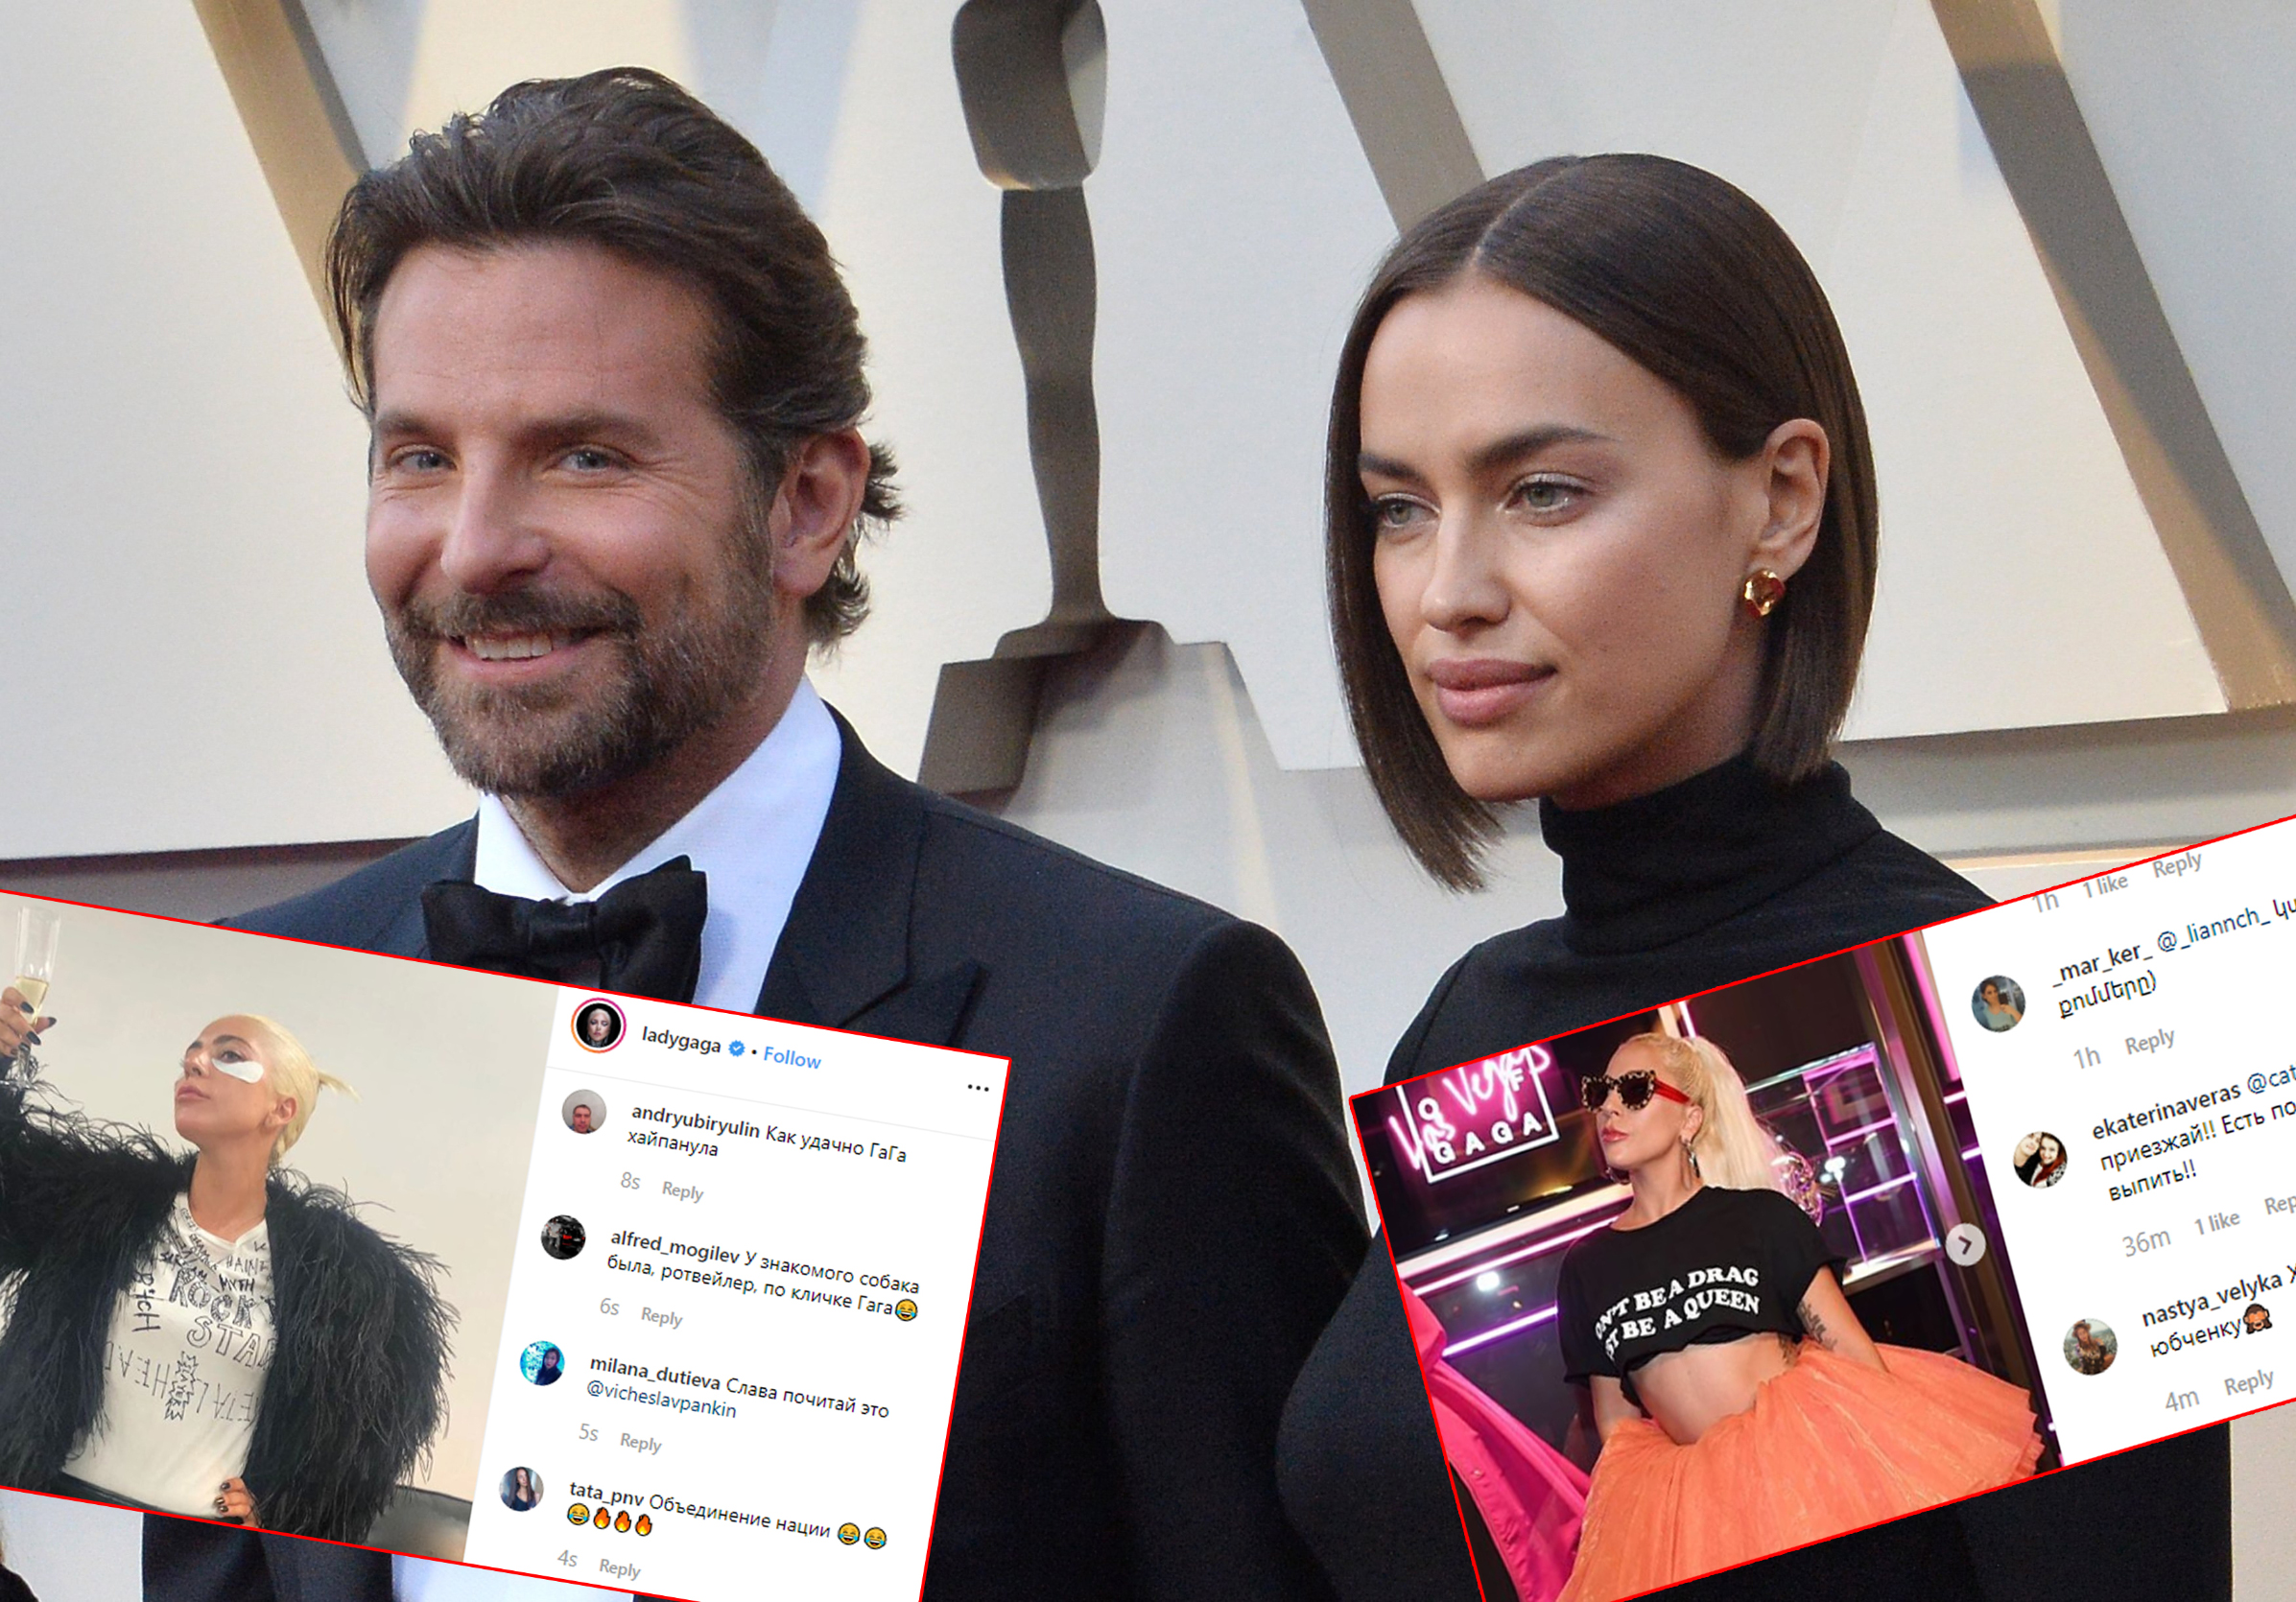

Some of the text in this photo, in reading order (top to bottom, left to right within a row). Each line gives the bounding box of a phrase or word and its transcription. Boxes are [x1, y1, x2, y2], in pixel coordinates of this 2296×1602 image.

[1433, 1111, 1543, 1165] GAGA
[169, 1266, 257, 1330] ROCK
[1595, 1265, 1759, 1340] ON'T BE A DRAG
[1621, 1317, 1657, 1340] BE
[1664, 1308, 1683, 1330] A
[1683, 1288, 1761, 1316] QUEEN
